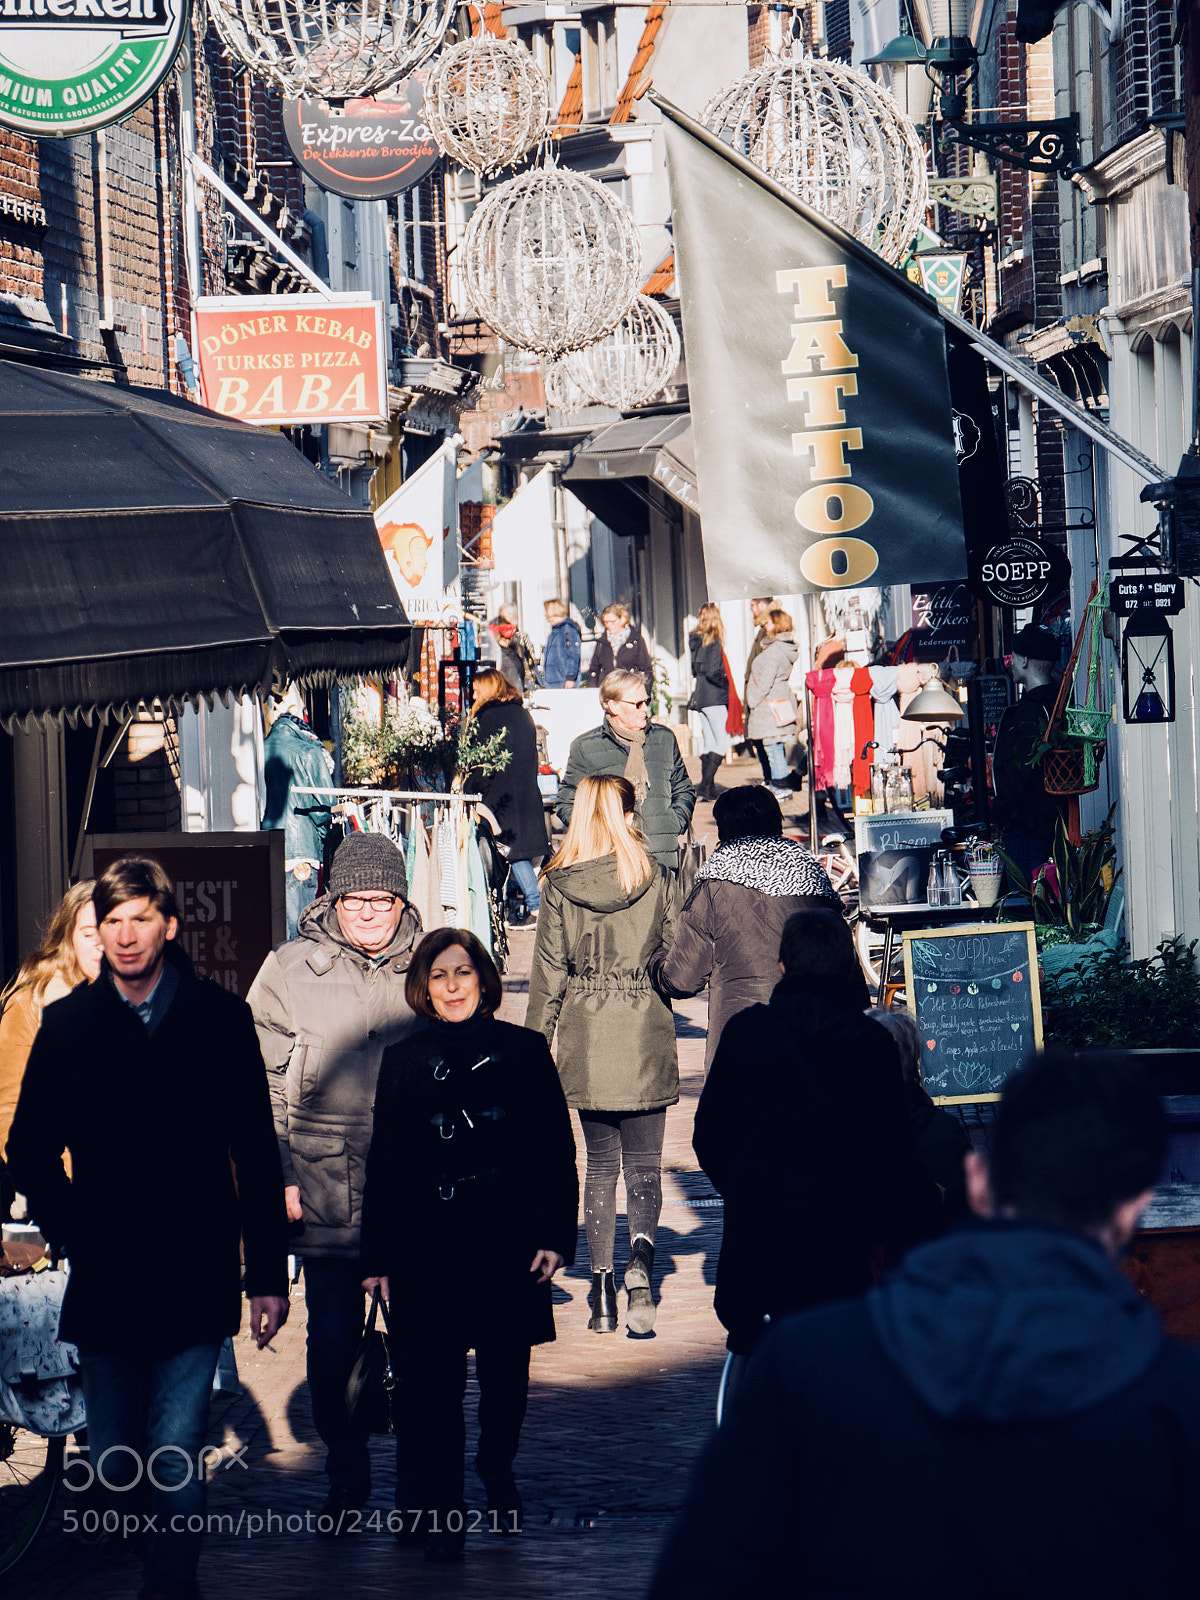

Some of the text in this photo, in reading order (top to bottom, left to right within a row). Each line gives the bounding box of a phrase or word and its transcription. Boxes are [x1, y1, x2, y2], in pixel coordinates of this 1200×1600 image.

[62, 48, 141, 106] QUALITY
[12, 106, 64, 120] NATUURLIJKE
[66, 92, 124, 119] GRONDSTOFFEN
[322, 146, 380, 160] Lekkerste
[201, 314, 373, 356] DÖNER KEBAB
[213, 351, 362, 371] TURKSE PIZZA
[214, 371, 371, 416] BABA
[776, 264, 879, 588] TATTOO
[981, 561, 1051, 582] SOEPP
[913, 584, 966, 611] Edith
[1118, 583, 1138, 595] Cuts
[1154, 582, 1176, 594] Glory
[1125, 599, 1138, 609] 072
[917, 604, 970, 636] Rijkers
[945, 938, 991, 966] SOEPP
